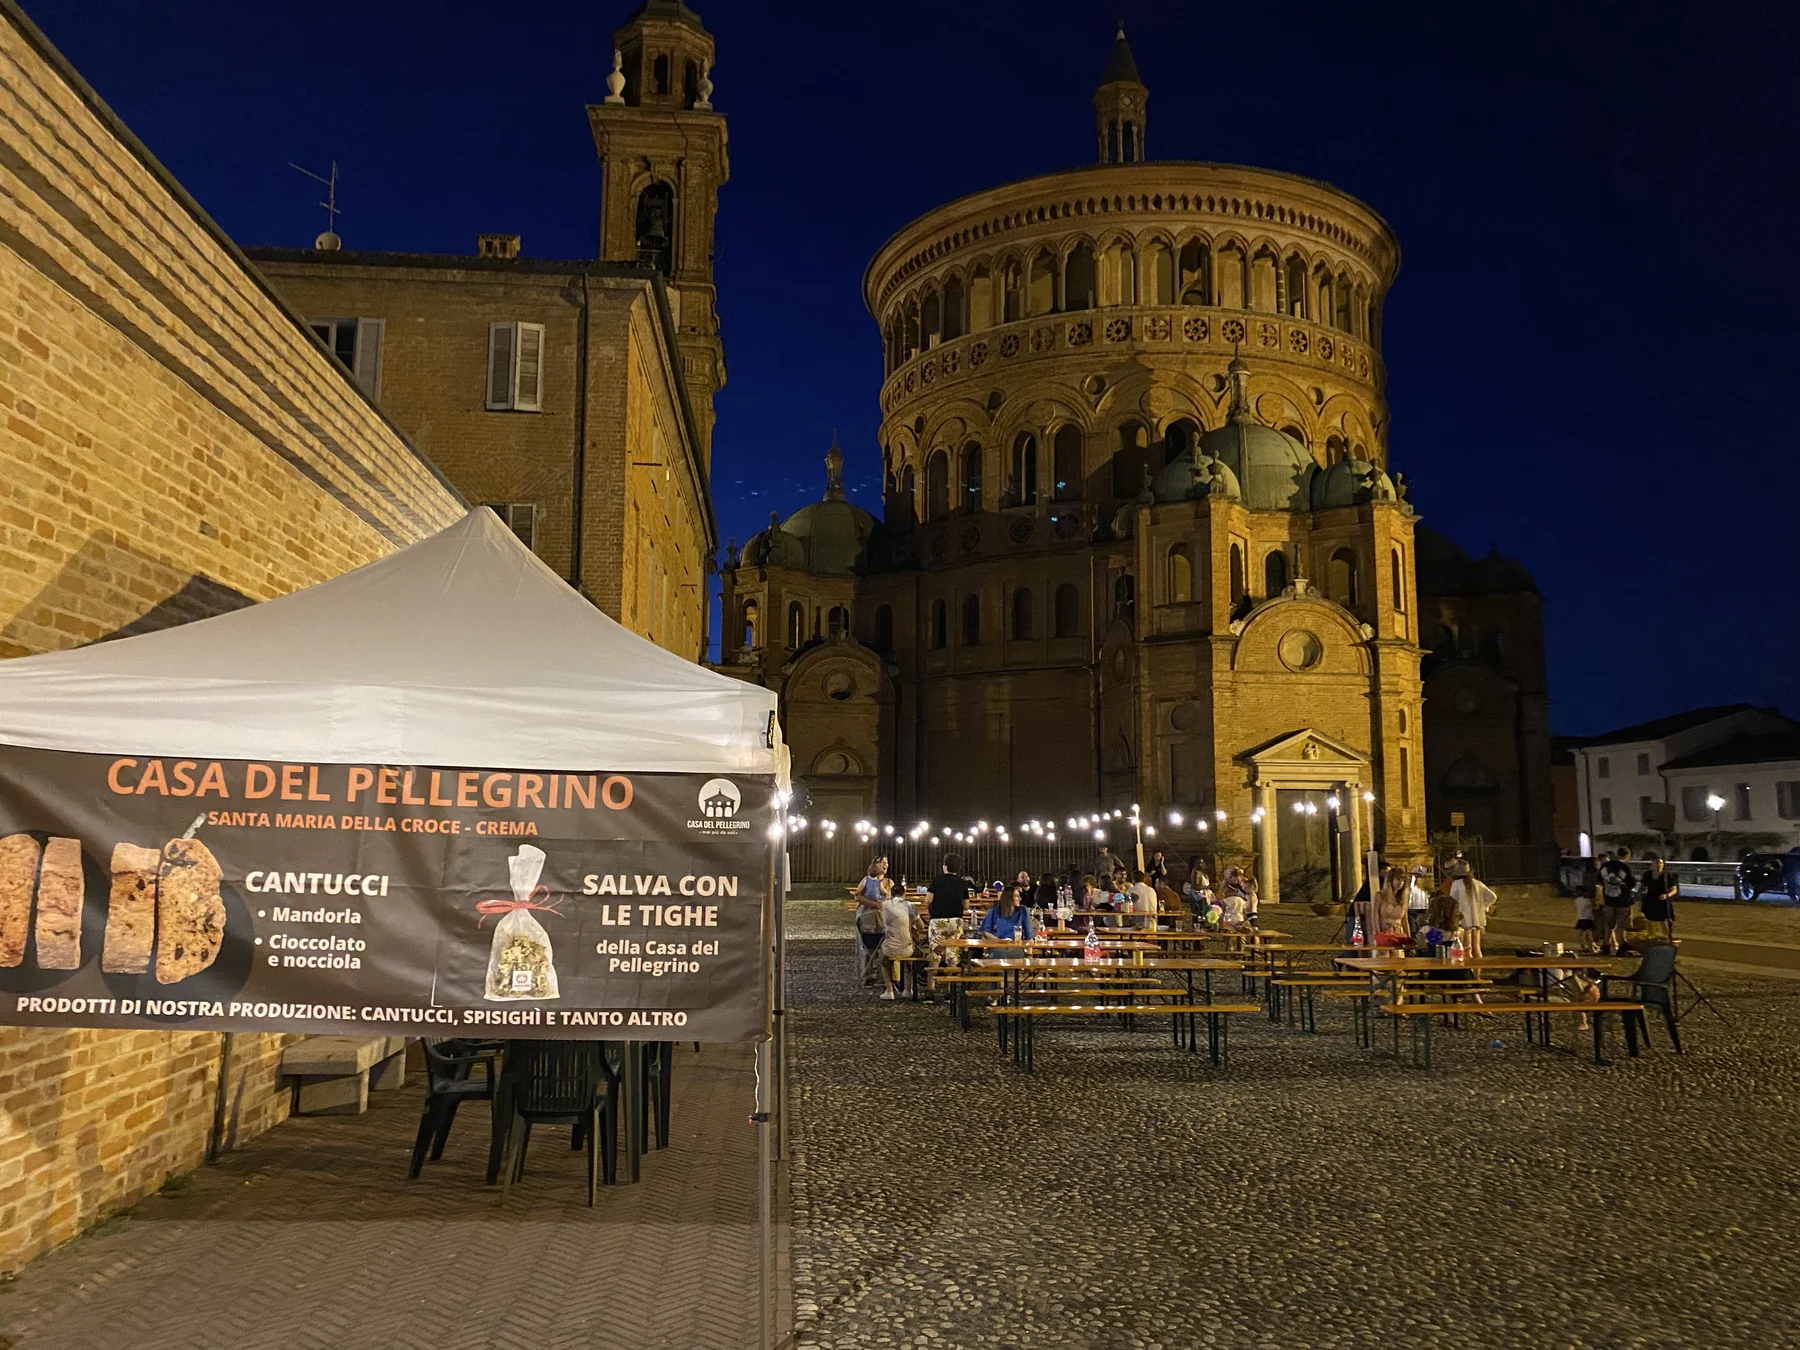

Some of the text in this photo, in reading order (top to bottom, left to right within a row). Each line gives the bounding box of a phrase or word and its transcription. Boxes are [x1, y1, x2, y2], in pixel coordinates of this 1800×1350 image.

[107, 758, 634, 810] CASA DEL PELLEGRINO
[207, 811, 271, 827] SANTA
[275, 813, 336, 829] MARIA
[340, 815, 397, 832] DELLA
[400, 818, 460, 834] CROCE
[475, 820, 539, 836] CREMA
[687, 820, 750, 829] CASA DEL PELLEGRINO
[245, 871, 389, 897] CANTUCCI
[582, 874, 739, 897] SALVA CON
[272, 906, 362, 924] Mandorla
[601, 904, 719, 927] LE TIGHE
[269, 933, 366, 951] Cioccolato
[596, 939, 719, 955] della Casa del
[267, 953, 361, 970] e nocciola
[608, 957, 700, 977] Pellegrino
[17, 996, 688, 1027] PRODOTTI DI NOSTRA PRODUZIONE: CANTUCCI, SPISIGHÌ E TANTO ALTRO
